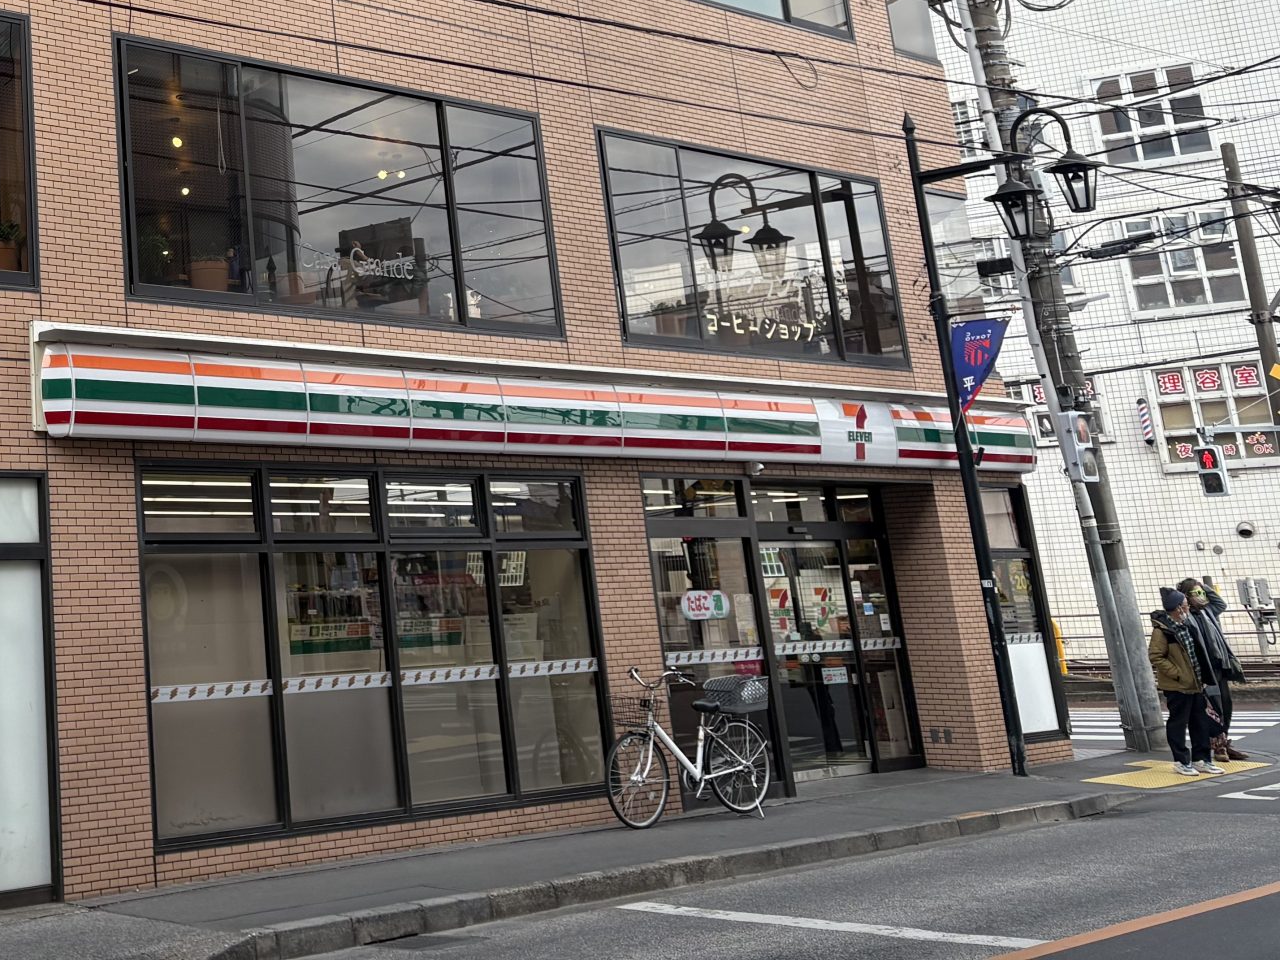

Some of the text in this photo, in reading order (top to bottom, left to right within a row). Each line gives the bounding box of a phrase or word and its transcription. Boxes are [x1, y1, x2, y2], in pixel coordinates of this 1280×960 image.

[350, 247, 415, 280] Grande
[1158, 366, 1260, 394] 理容室
[1253, 444, 1275, 454] OK
[686, 594, 711, 613] たばこ
